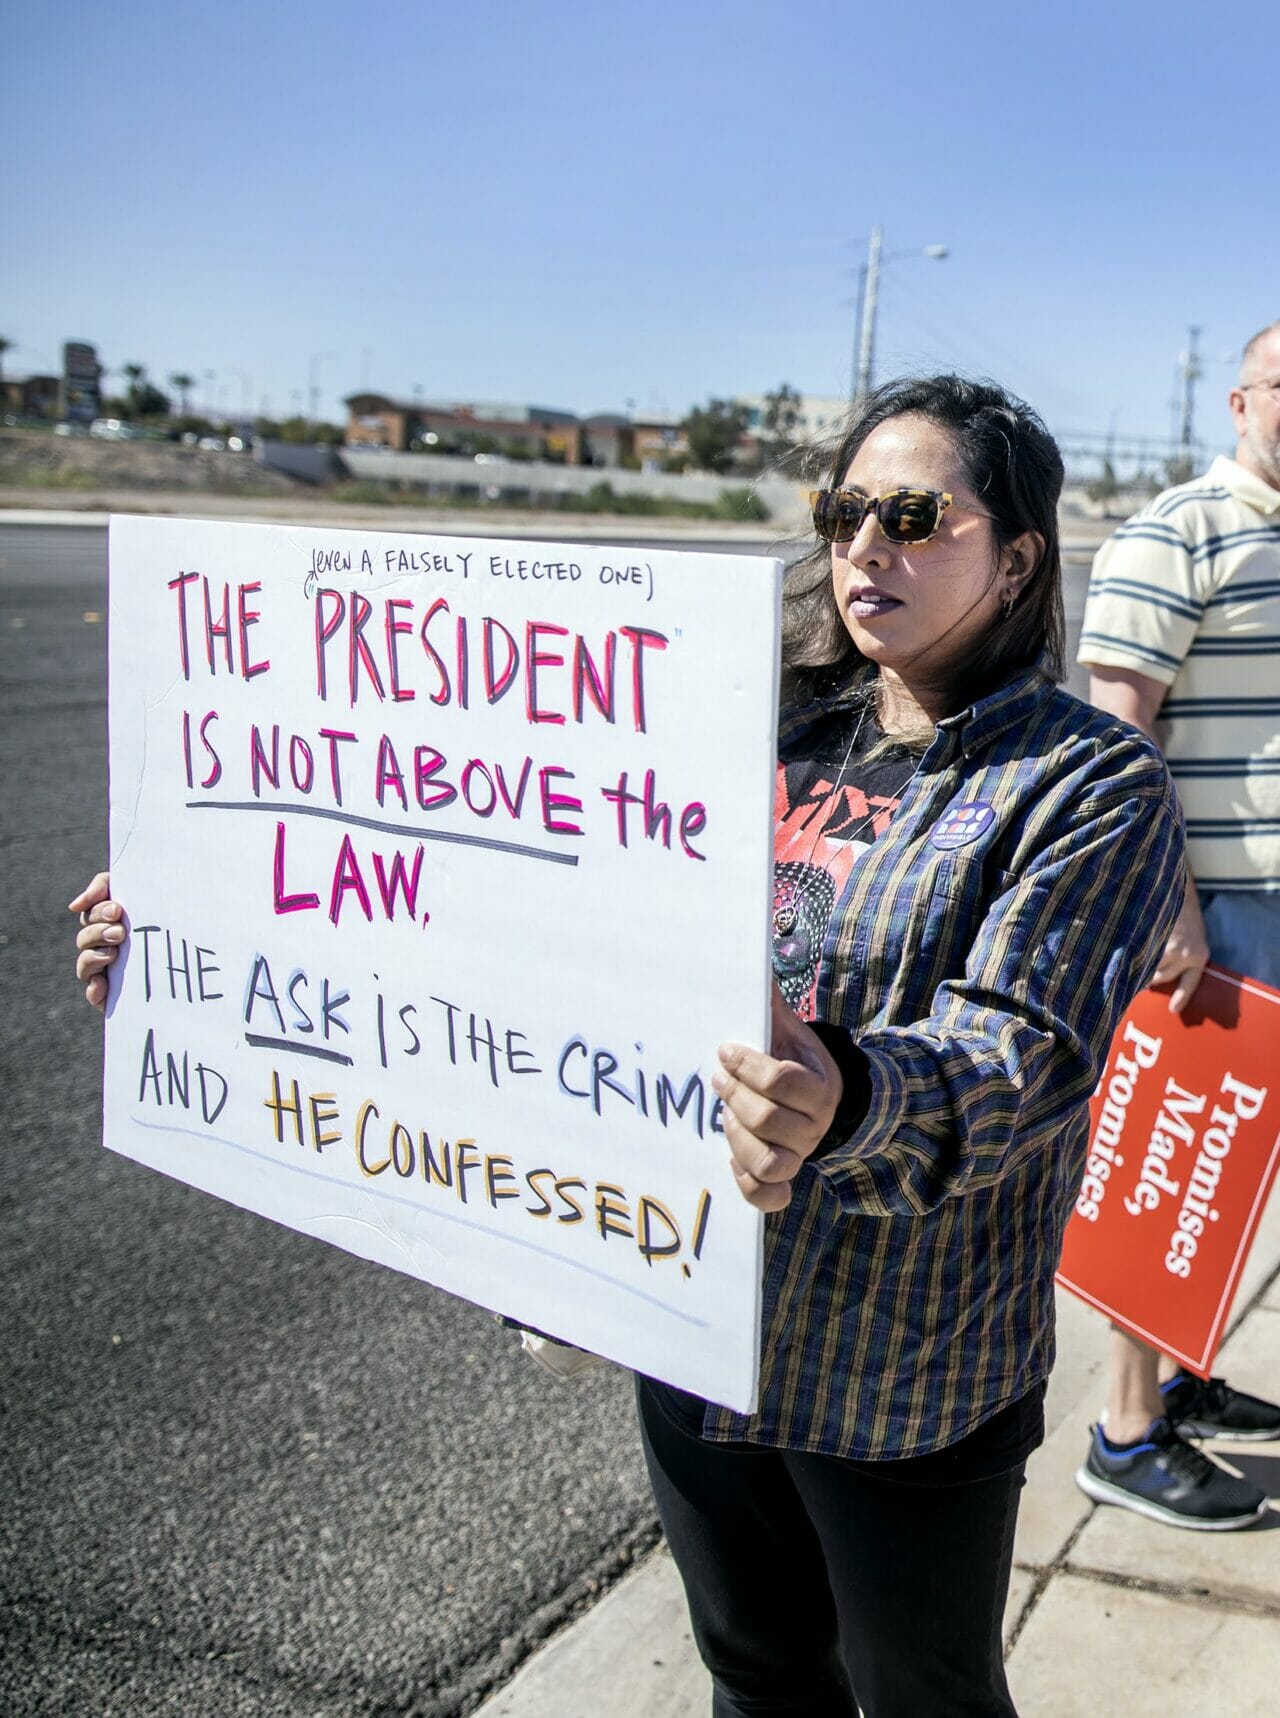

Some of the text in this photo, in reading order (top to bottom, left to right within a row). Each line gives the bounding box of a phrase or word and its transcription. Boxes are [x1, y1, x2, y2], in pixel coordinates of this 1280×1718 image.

[168, 571, 270, 681] THE
[361, 550, 374, 576] A
[385, 550, 472, 578] FALSELY
[490, 556, 582, 581] ELECTED
[599, 563, 653, 601] ONE)
[183, 710, 706, 861] IS NOT ABOVE the
[273, 821, 430, 929] LAW.
[133, 925, 224, 1003] THE
[244, 952, 353, 1041] ASK
[430, 996, 542, 1087] THE
[139, 1028, 713, 1281] AND HE CONFESSED!
[1075, 1020, 1163, 1222] Promises
[1123, 1076, 1207, 1216] Made,
[1165, 1071, 1267, 1278] Promises
